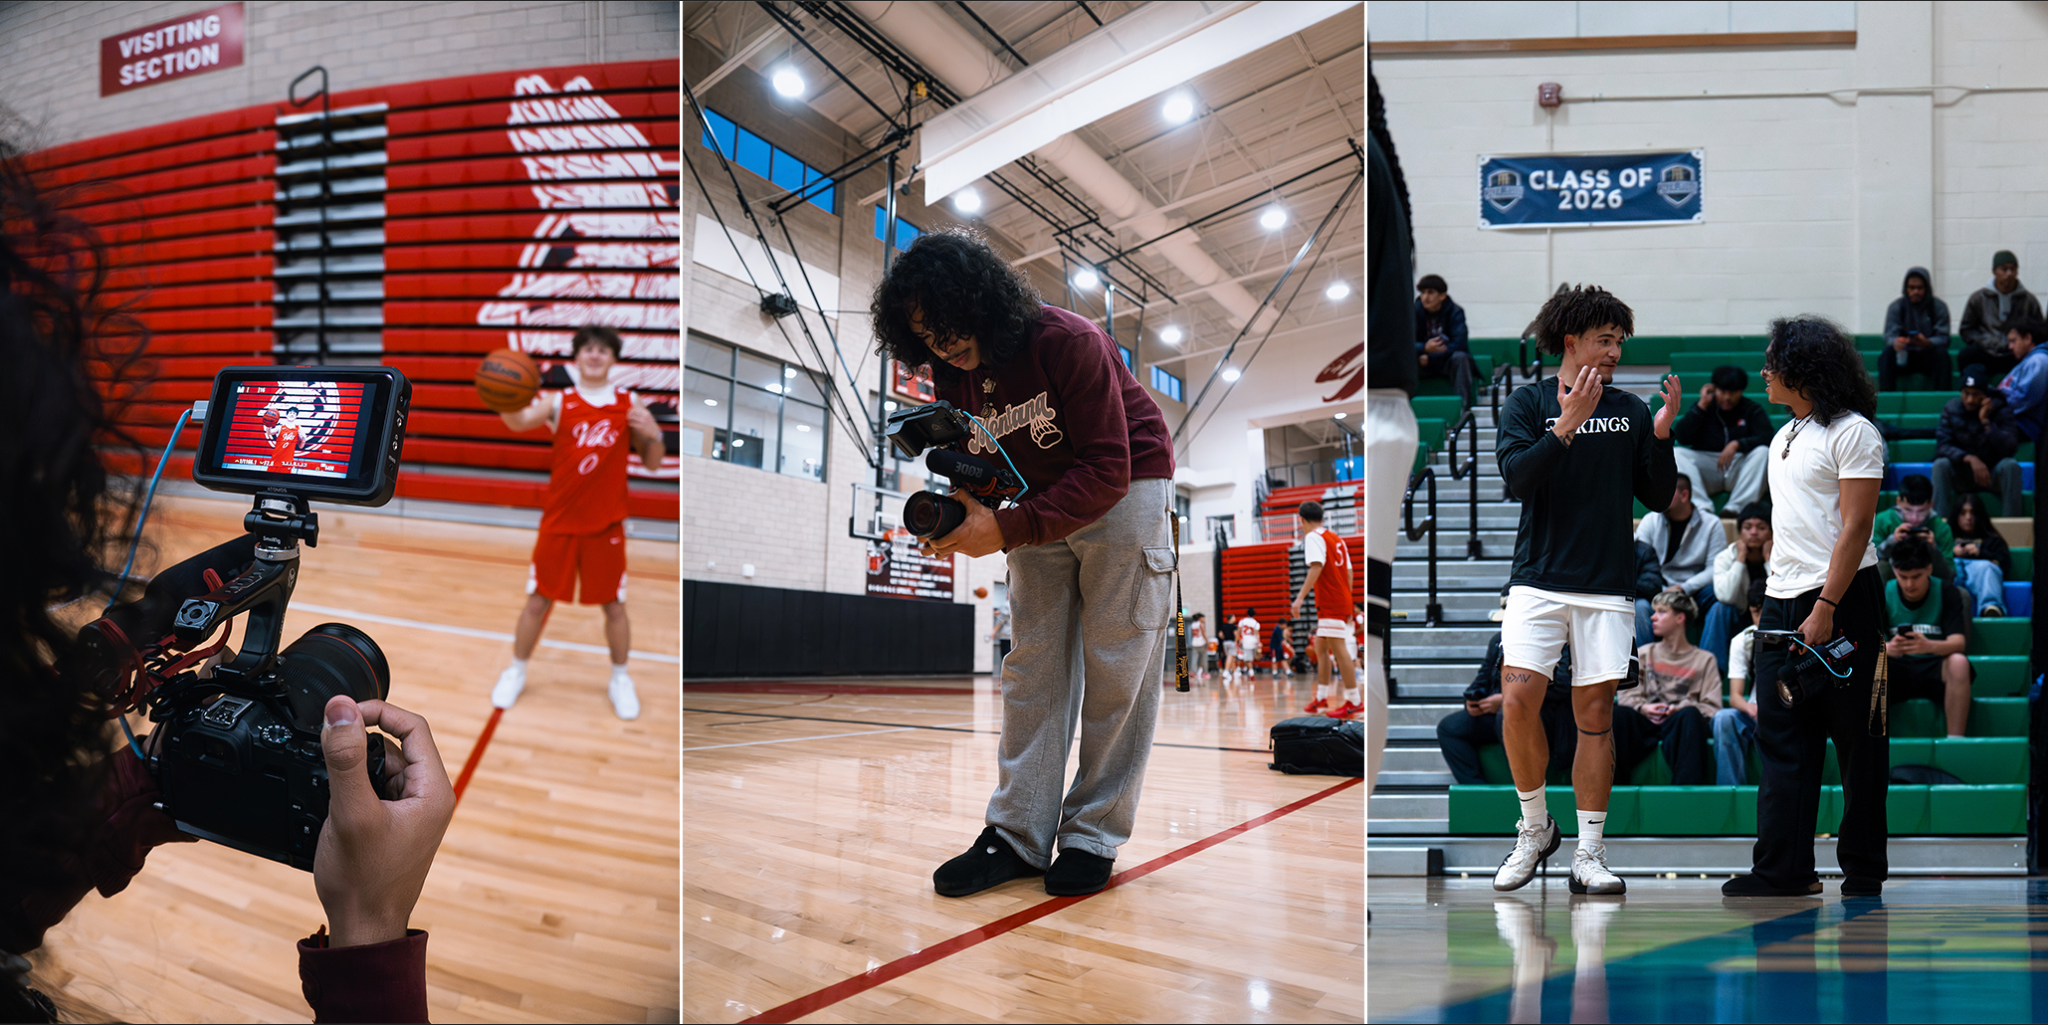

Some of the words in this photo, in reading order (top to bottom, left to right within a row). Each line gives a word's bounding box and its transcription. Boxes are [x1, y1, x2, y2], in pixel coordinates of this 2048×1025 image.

[118, 15, 220, 59] VISITING
[119, 43, 219, 86] SECTION
[1528, 170, 1611, 190] CLASS
[1619, 168, 1653, 188] OF
[1558, 188, 1623, 210] 2026
[968, 391, 1056, 455] Montana
[1334, 542, 1344, 567] 5
